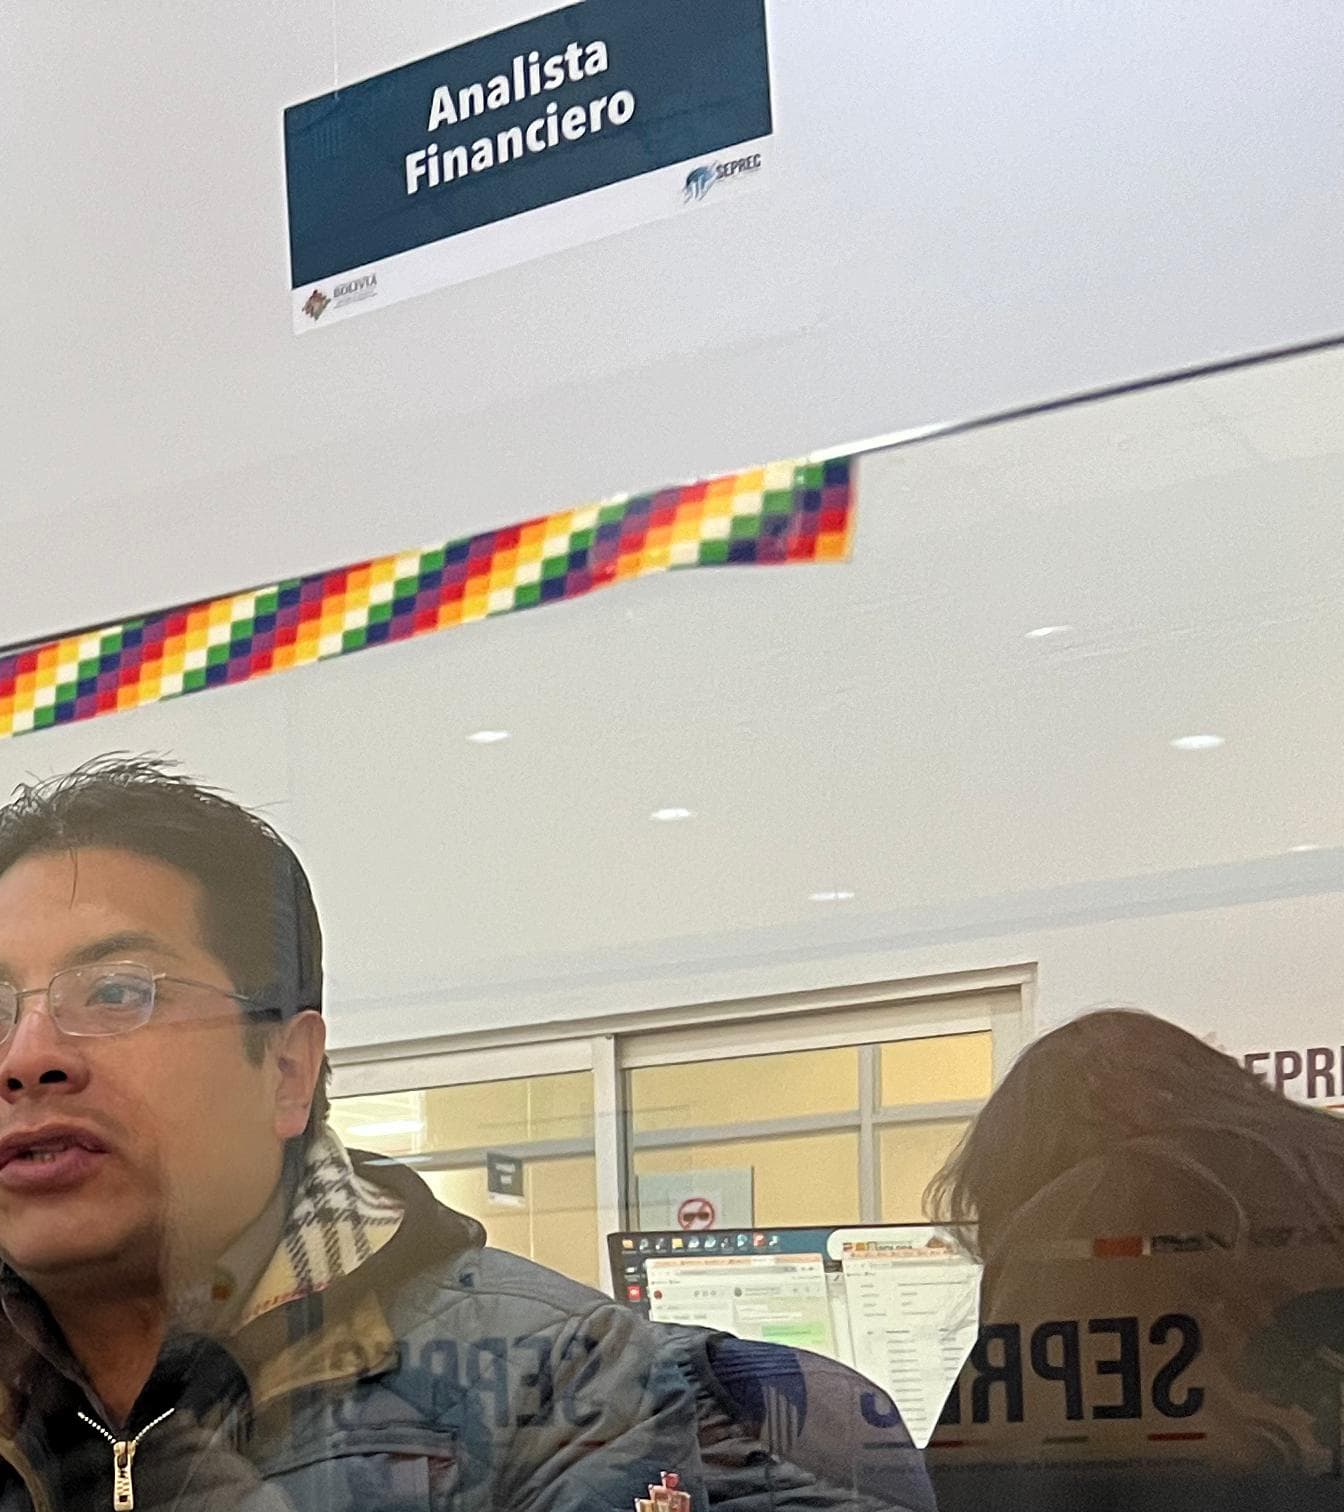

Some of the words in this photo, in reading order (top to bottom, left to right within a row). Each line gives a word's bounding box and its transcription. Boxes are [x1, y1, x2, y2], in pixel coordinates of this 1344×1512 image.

[428, 38, 609, 131] Analista
[405, 90, 636, 196] Financiero
[715, 153, 762, 180] SEPREC
[1244, 1046, 1344, 1099] EPR
